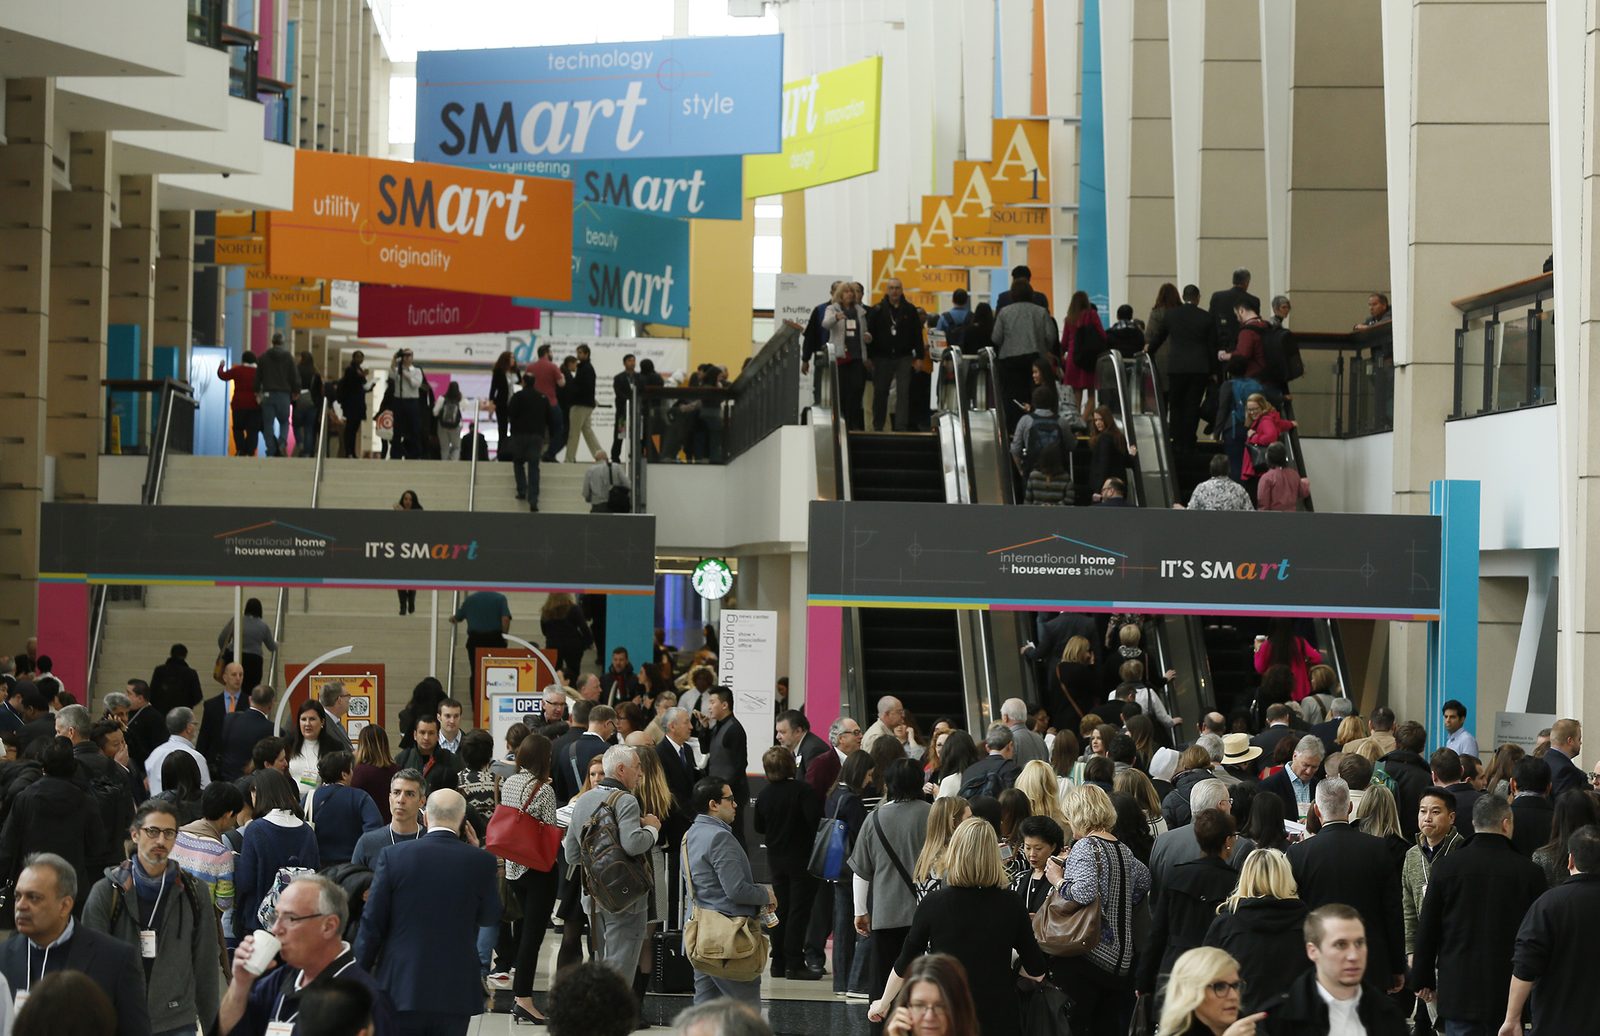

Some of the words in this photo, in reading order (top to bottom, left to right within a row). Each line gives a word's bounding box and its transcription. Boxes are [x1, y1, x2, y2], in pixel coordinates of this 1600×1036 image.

[548, 49, 654, 70] technology
[683, 92, 735, 119] style
[439, 81, 648, 157] SMart
[993, 123, 1047, 181] A
[583, 169, 706, 214] SMart
[953, 165, 993, 217] A
[313, 194, 361, 224] utility
[377, 173, 529, 242] SMart
[993, 209, 1046, 224] SOUTH
[217, 243, 263, 255] NORTH
[585, 227, 620, 252] beauty
[953, 245, 1001, 256] SOUTH
[379, 244, 452, 272] originality
[921, 270, 966, 282] SOUTH
[271, 292, 311, 302] NORTH
[588, 262, 675, 321] SMart
[407, 304, 461, 326] function
[225, 536, 293, 547] international
[295, 537, 327, 548] home
[235, 546, 297, 557] housewares
[298, 547, 325, 558] show
[365, 541, 395, 559] IT'S
[400, 539, 479, 561] SMart
[999, 551, 1078, 565] international
[1079, 553, 1117, 566] home
[1011, 563, 1082, 576] housewares
[1083, 565, 1115, 577] show
[1160, 559, 1195, 579] IT'S
[1199, 557, 1291, 581] SMart
[722, 614, 739, 671] building
